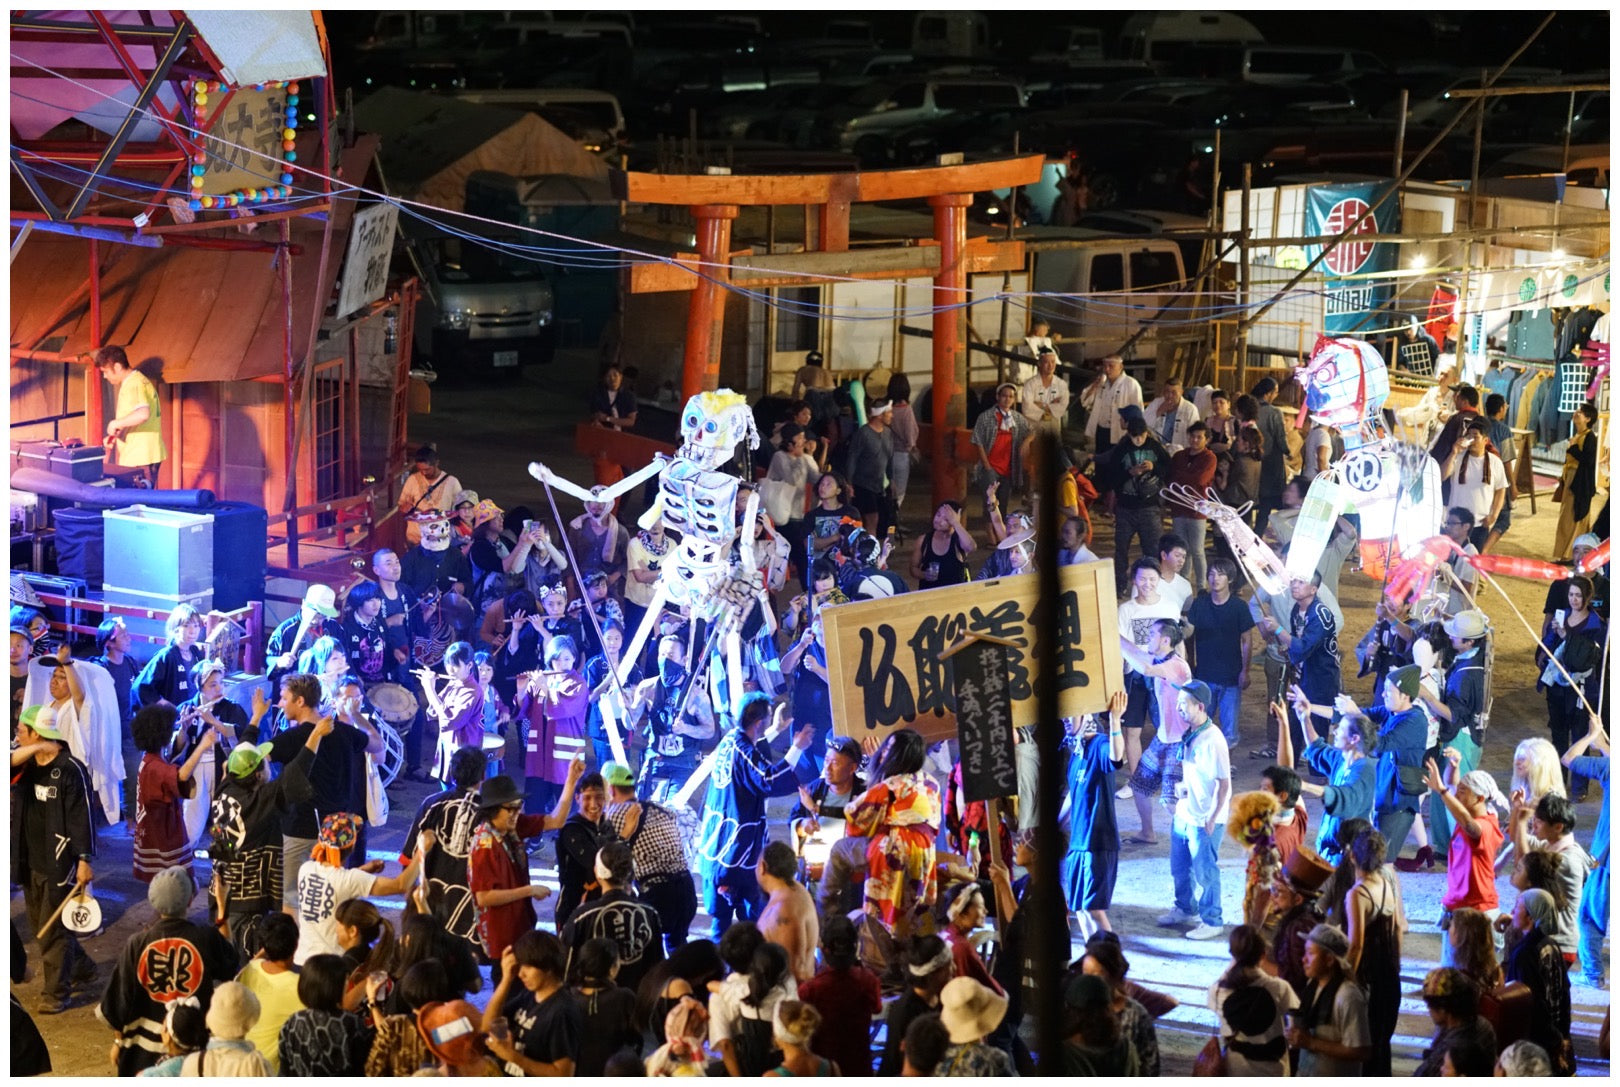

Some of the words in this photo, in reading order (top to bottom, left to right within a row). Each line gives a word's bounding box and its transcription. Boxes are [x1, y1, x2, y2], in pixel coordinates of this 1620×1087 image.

[957, 678, 983, 775] 手ぬぐいつき
[978, 646, 1015, 788] 投げ銭二千円以上で
